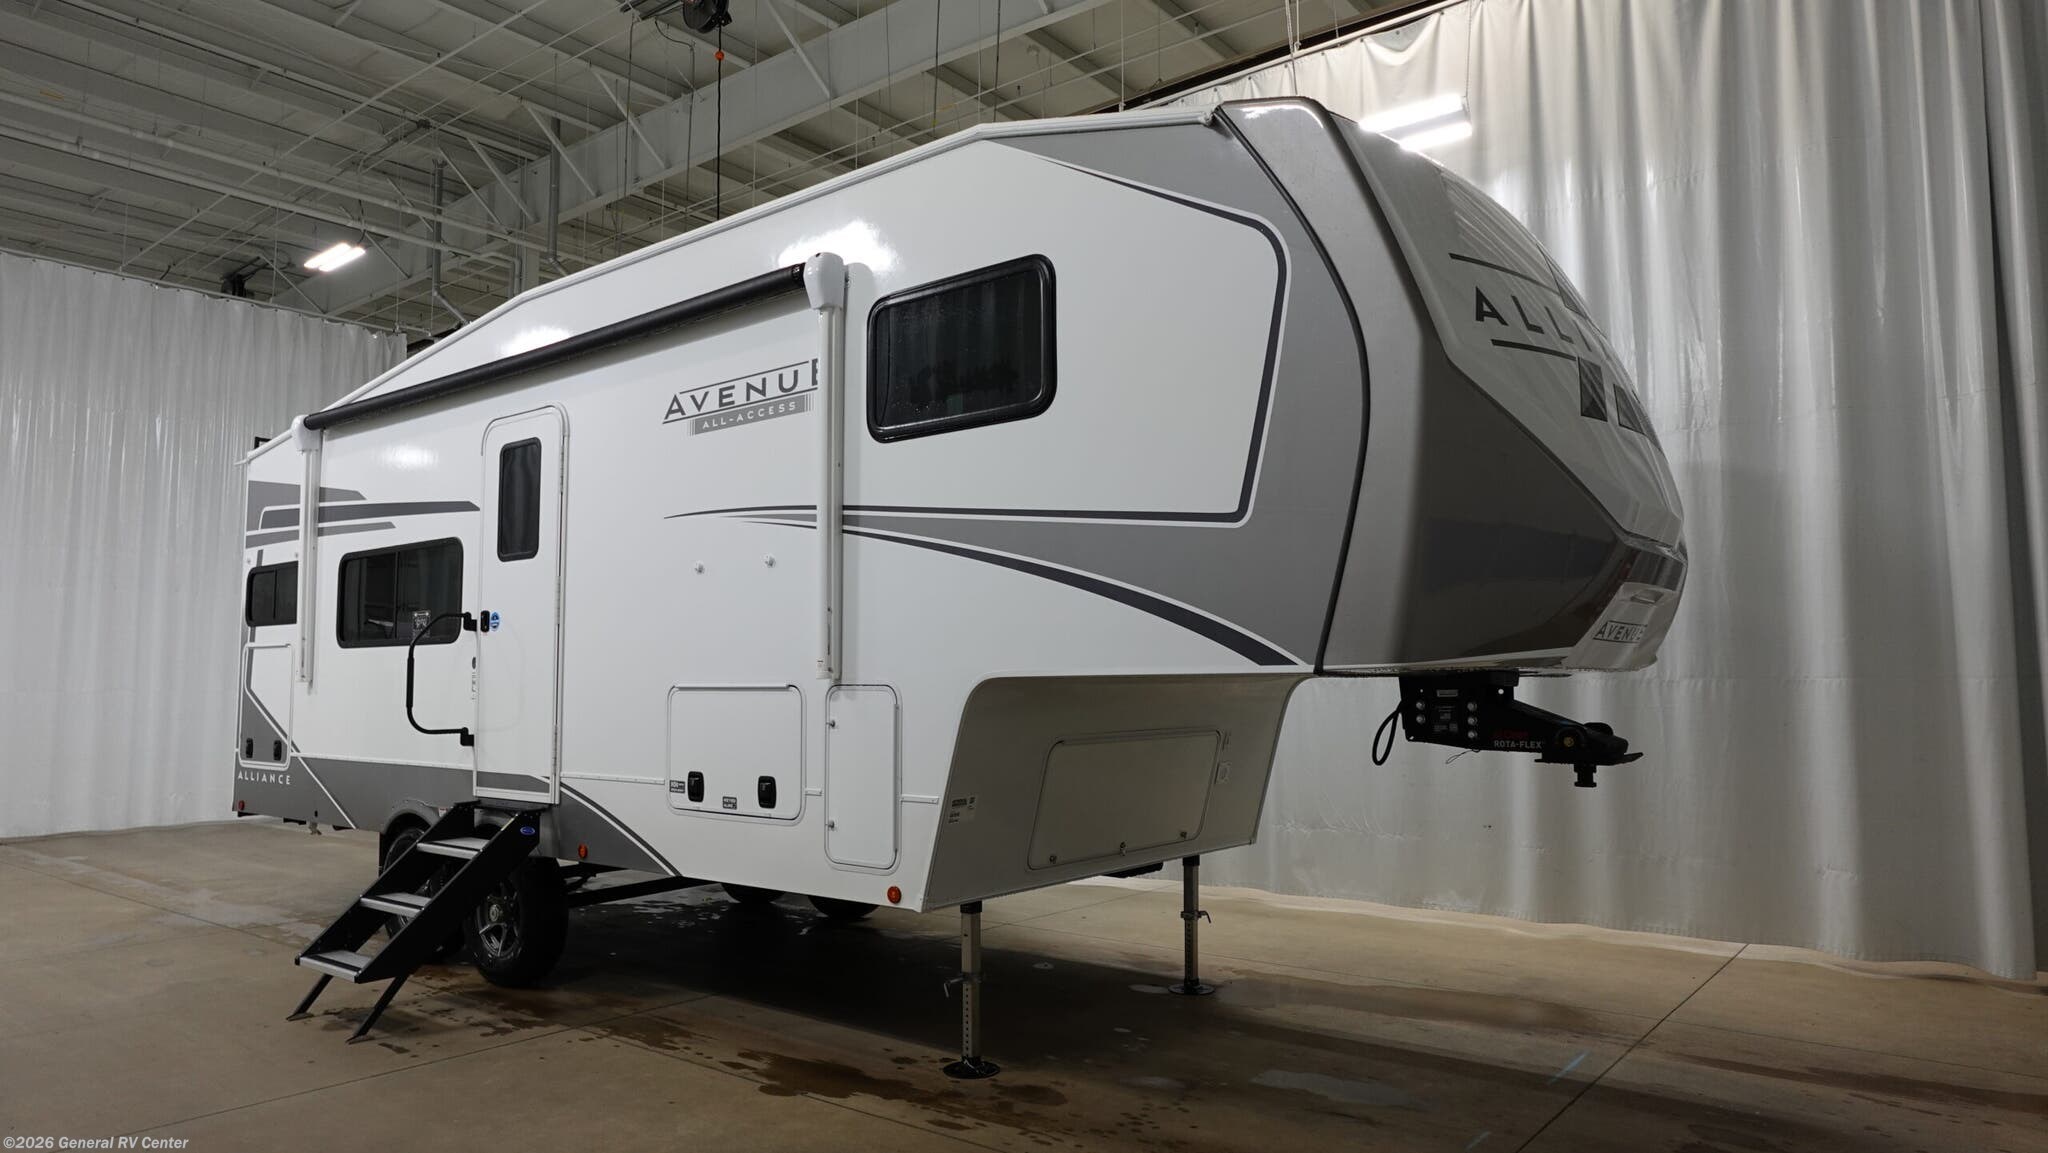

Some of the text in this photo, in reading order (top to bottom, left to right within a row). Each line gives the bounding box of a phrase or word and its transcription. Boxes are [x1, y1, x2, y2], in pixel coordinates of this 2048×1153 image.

[1475, 286, 1610, 357] ALLI
[702, 401, 797, 430] ALL-ACCESS
[1493, 739, 1543, 749] ROTA-FLEX
[237, 770, 291, 785] ALLIANCE
